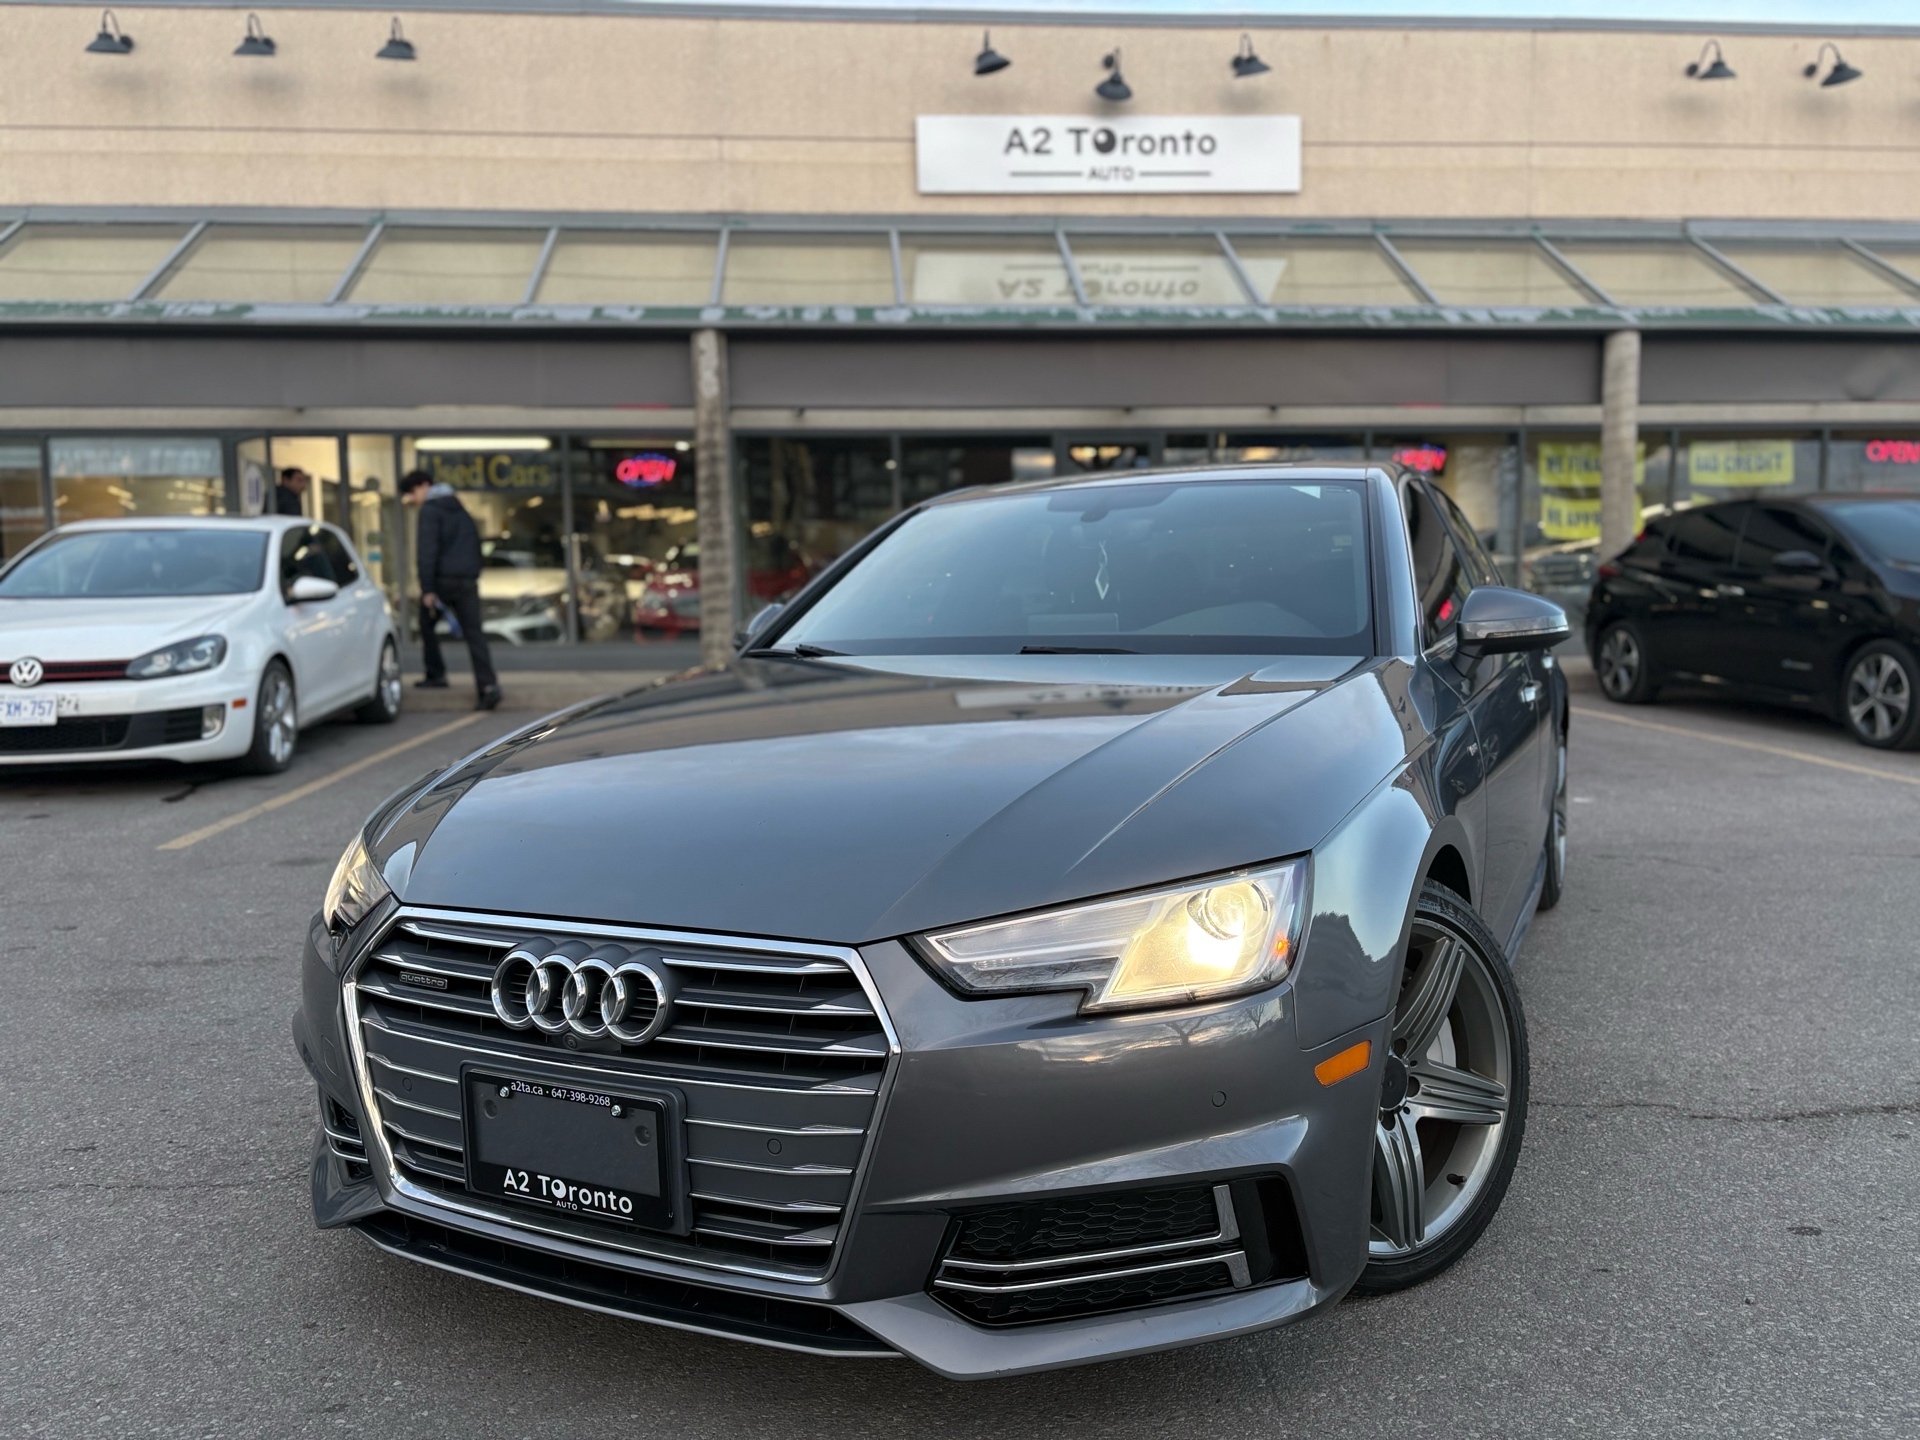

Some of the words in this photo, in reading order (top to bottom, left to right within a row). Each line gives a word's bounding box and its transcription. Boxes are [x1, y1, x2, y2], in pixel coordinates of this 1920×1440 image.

[1003, 127, 1053, 155] A2
[1087, 167, 1135, 180] AUTO
[487, 454, 550, 488] Cars
[616, 458, 677, 483] OPEN
[400, 973, 445, 987] quattro
[510, 1081, 544, 1097] a2ta.ca
[551, 1087, 611, 1107] 647-398-9268
[503, 1168, 530, 1194] A2
[556, 1201, 578, 1211] AUTO
